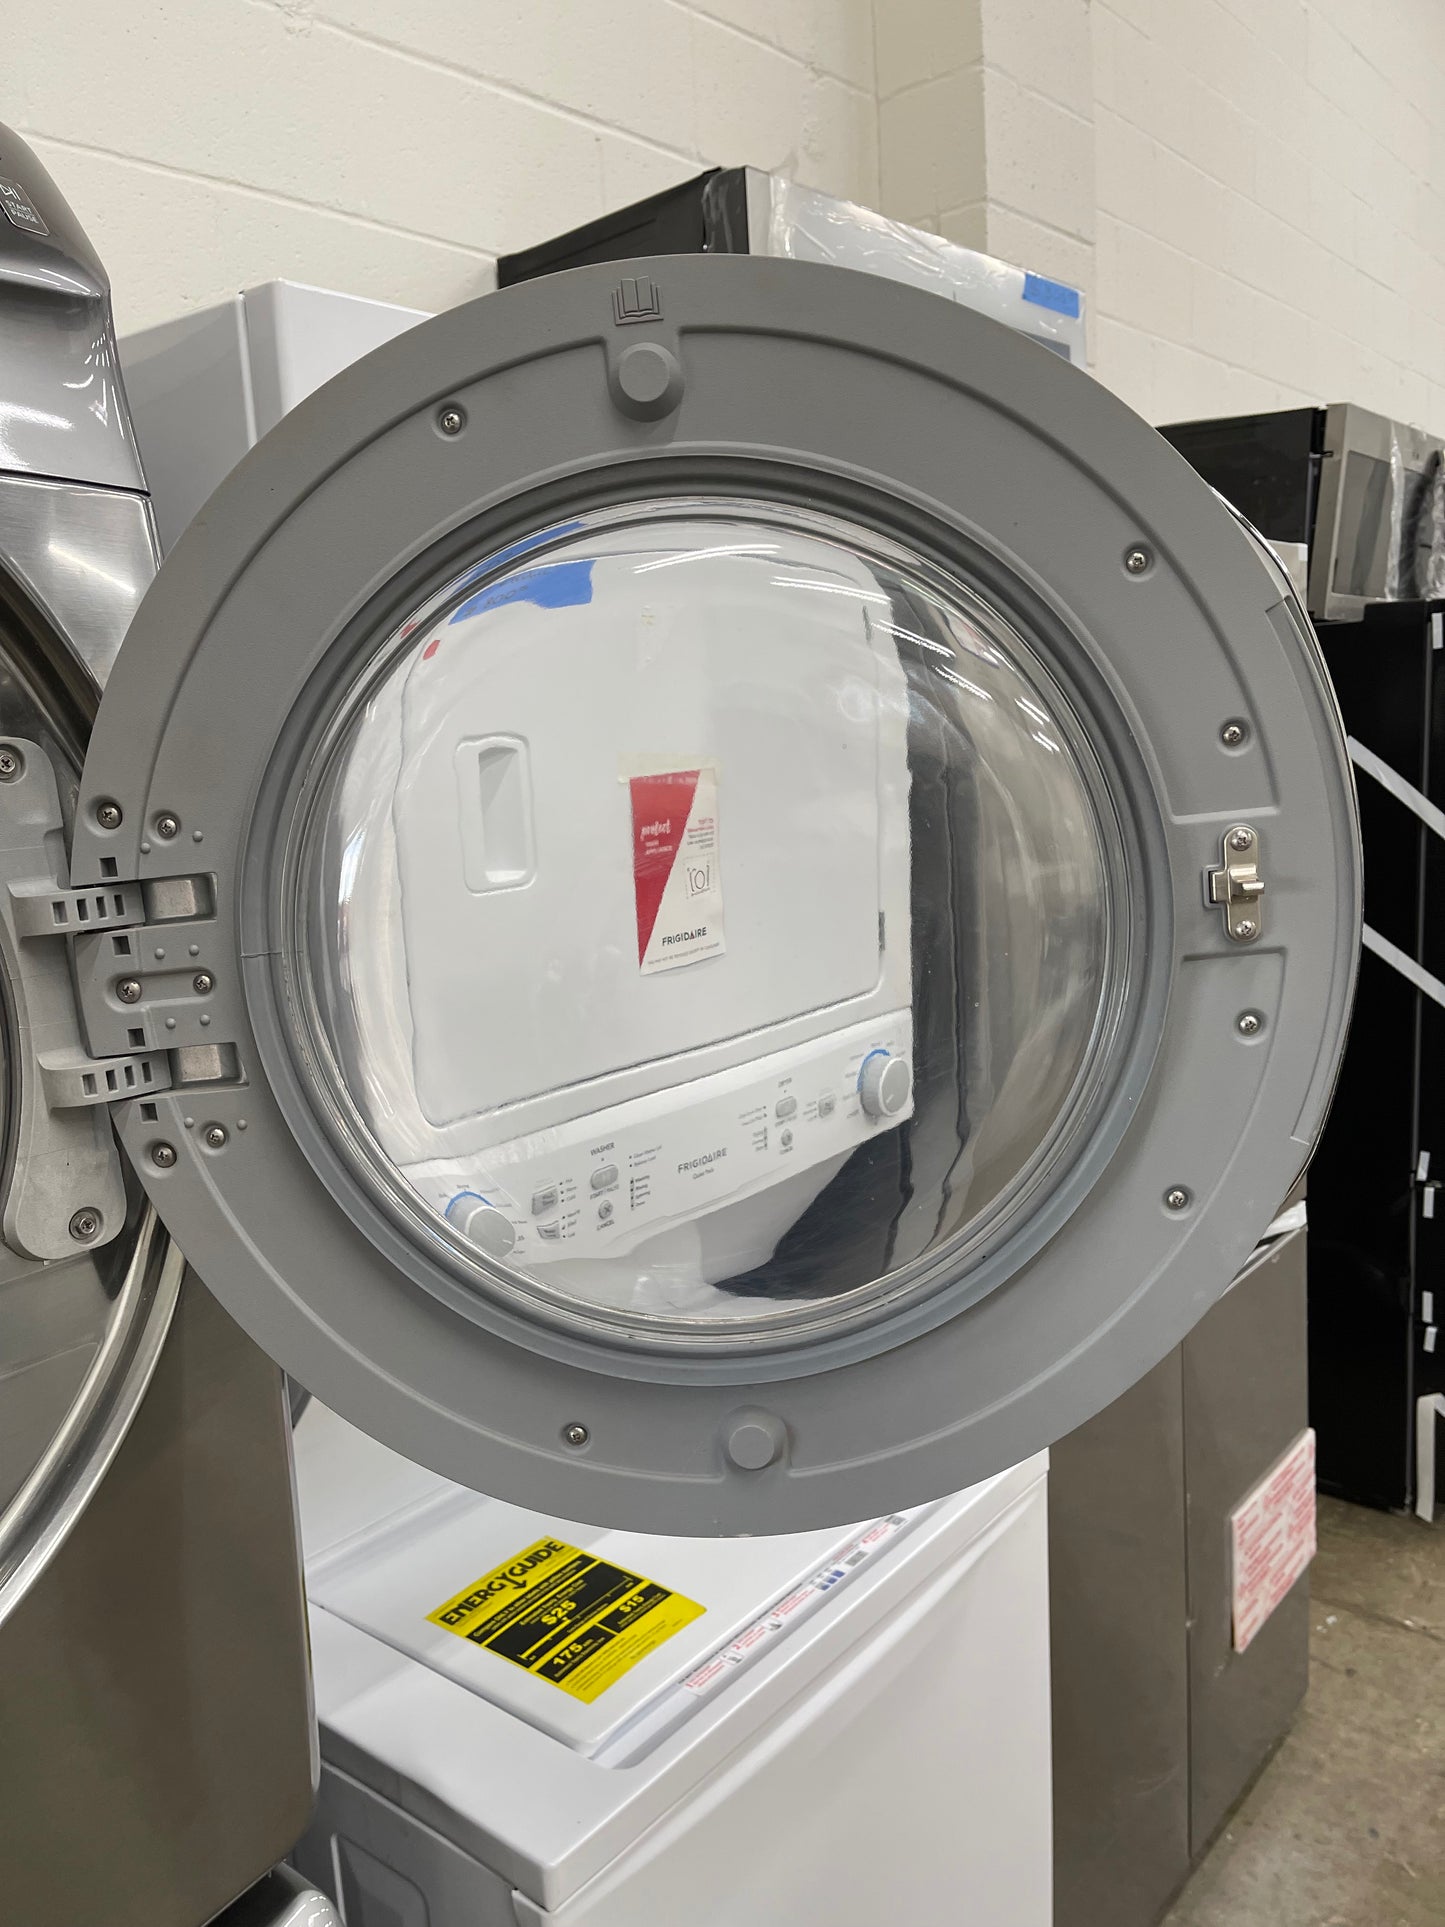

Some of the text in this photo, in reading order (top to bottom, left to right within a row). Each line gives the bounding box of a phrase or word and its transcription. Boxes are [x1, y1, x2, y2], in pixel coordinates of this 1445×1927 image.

[661, 927, 707, 947] FRIGIDAIRE
[590, 1142, 615, 1156] WASHER
[677, 1147, 728, 1174] FRIGIDAIRE
[439, 1541, 564, 1626] ENERGYGUIDE
[541, 1600, 577, 1625] $25
[619, 1594, 645, 1613] $15
[553, 1642, 583, 1665] 175
